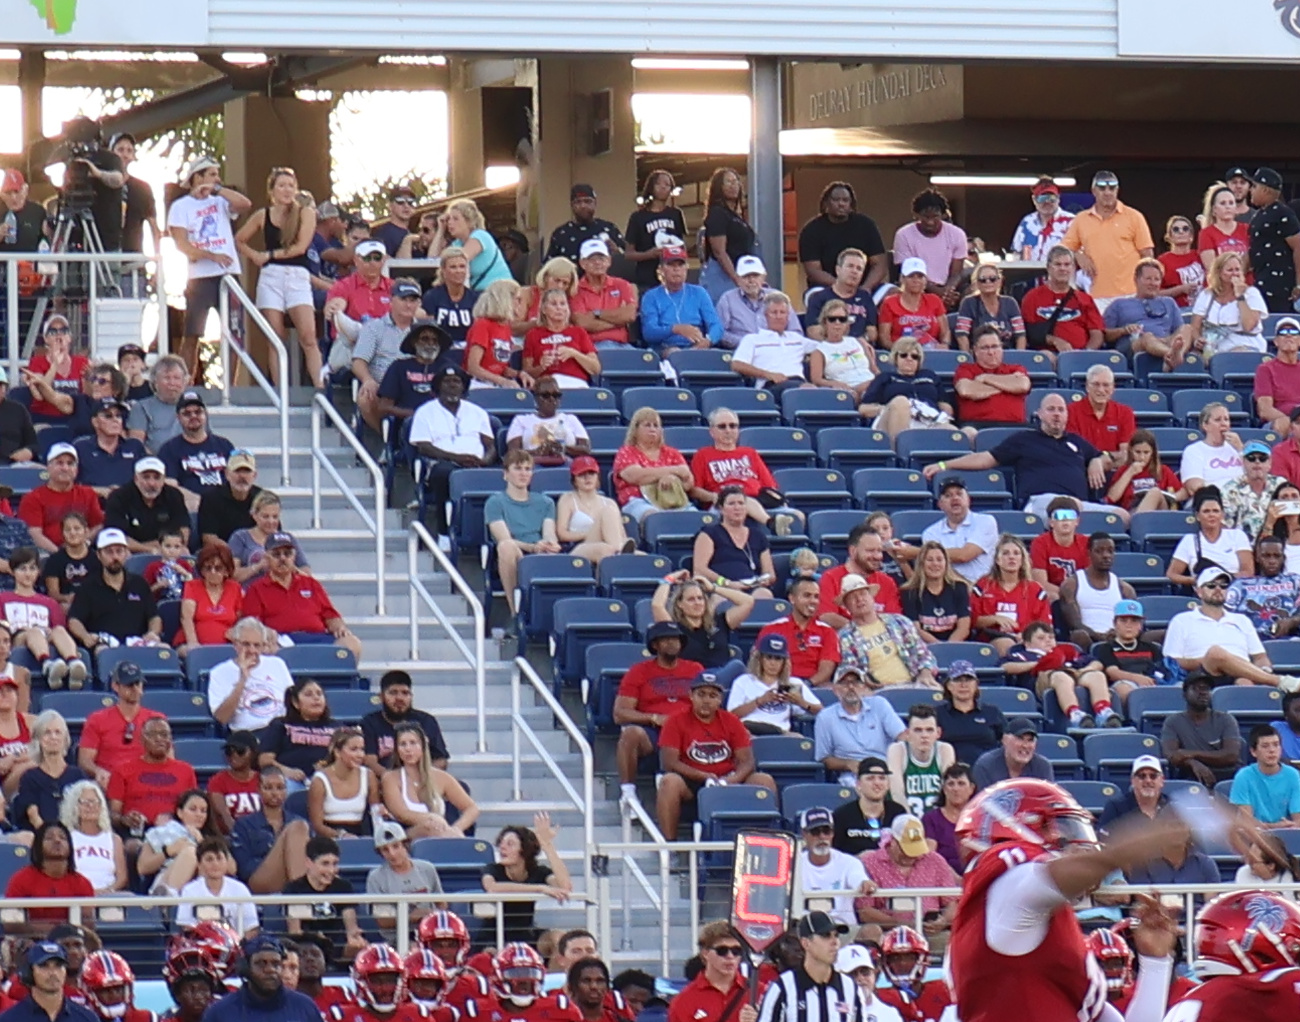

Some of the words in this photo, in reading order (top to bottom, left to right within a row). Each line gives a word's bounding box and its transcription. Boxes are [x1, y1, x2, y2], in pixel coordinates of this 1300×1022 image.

[809, 85, 853, 122] DELRAY
[857, 69, 911, 109] HYUNDAI
[437, 308, 472, 327] FAU
[906, 774, 942, 795] CELTICS
[77, 846, 110, 860] FAU
[736, 836, 789, 924] 2
